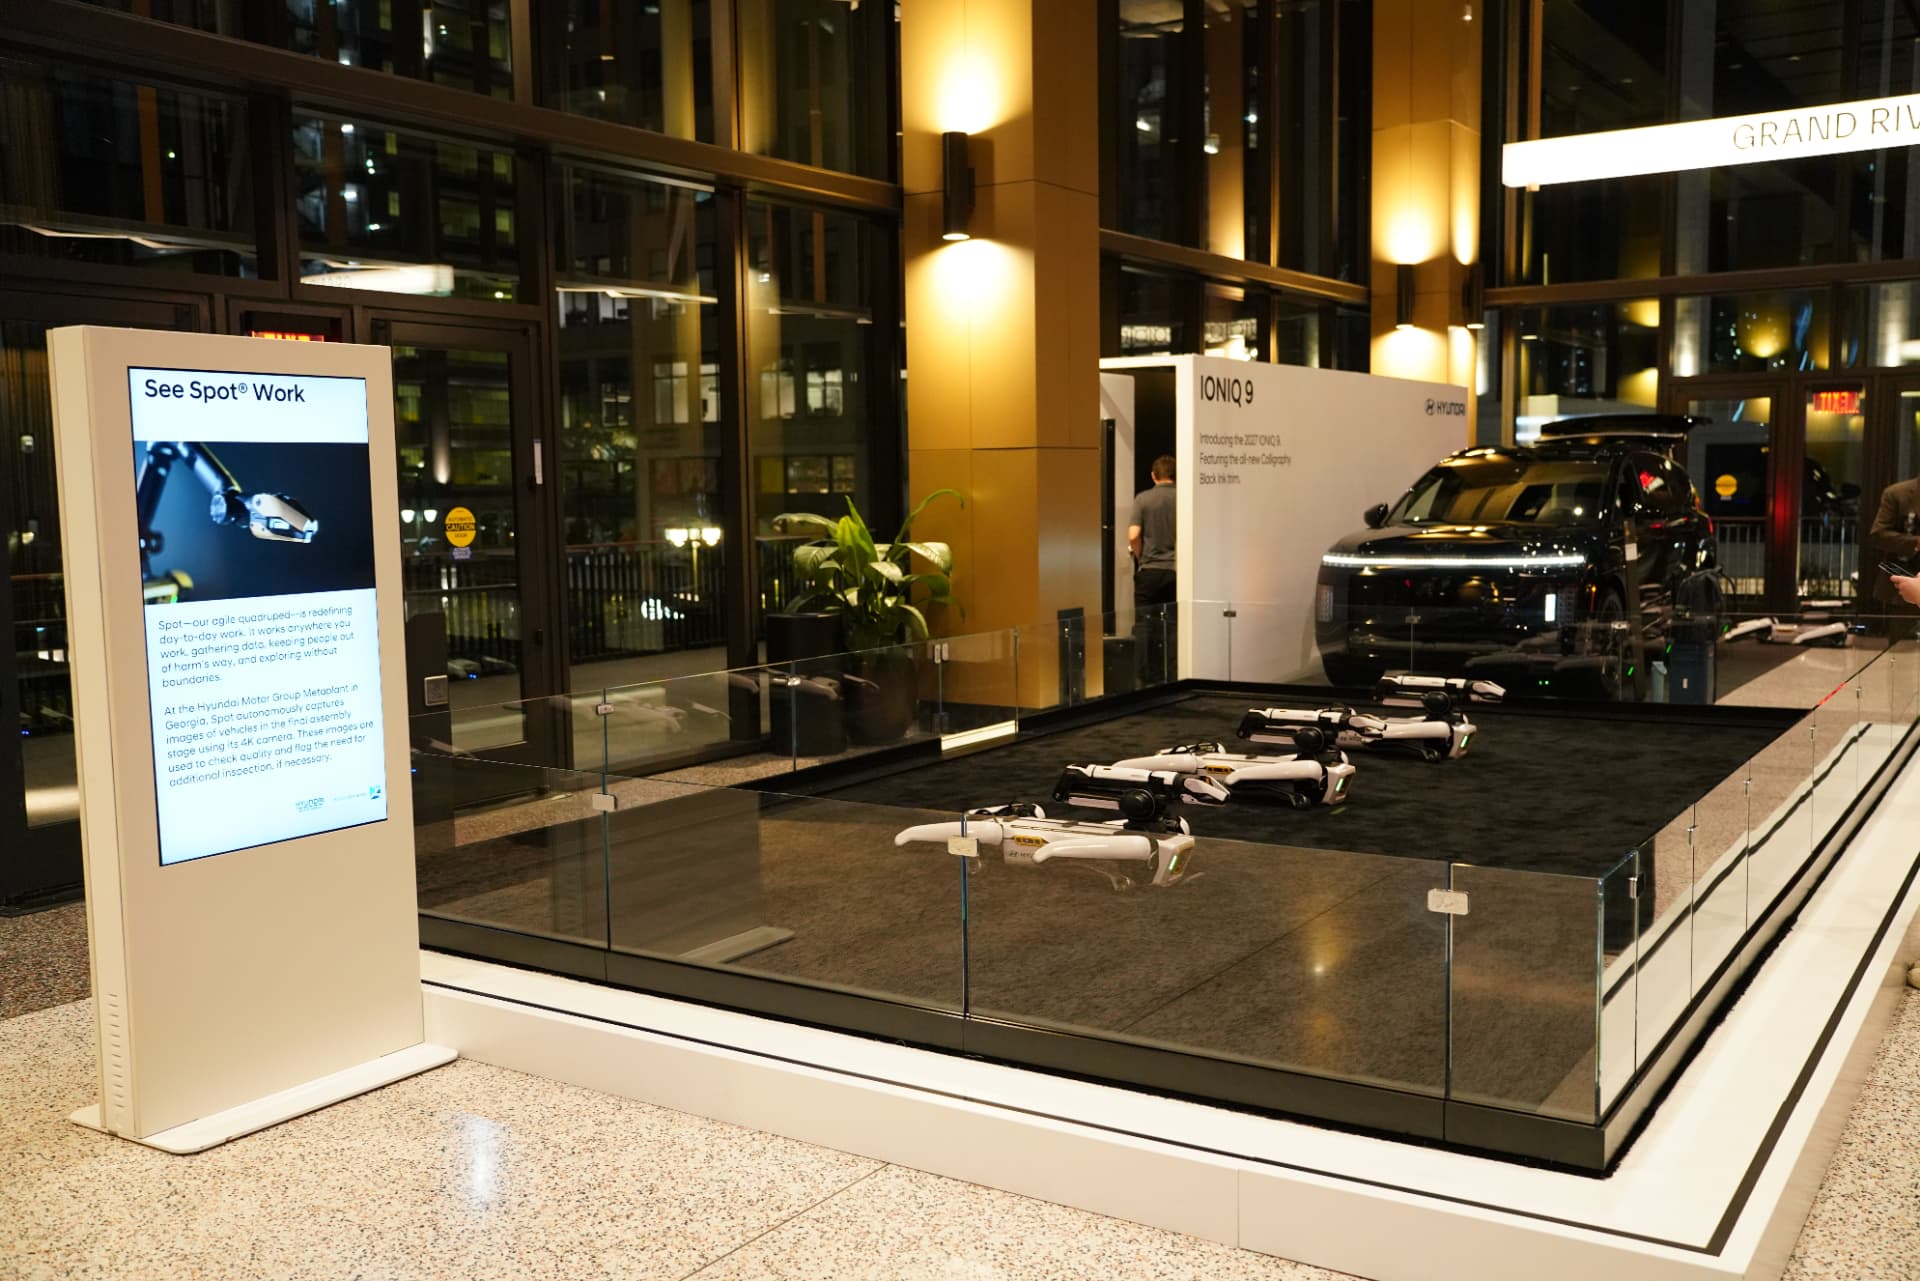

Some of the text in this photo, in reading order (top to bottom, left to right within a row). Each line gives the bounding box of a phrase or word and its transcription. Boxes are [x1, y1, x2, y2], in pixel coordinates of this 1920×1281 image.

[1733, 112, 1857, 150] GRAND
[145, 379, 306, 403] See Spot® Work
[1200, 375, 1253, 408] IONIQ 9
[1200, 432, 1233, 448] Introducing
[1233, 434, 1243, 446] the
[1259, 434, 1276, 448] IONIQ
[1200, 452, 1291, 468] Featuring the all-new Calligraphy
[1200, 472, 1216, 484] Black
[446, 523, 475, 531] CAUTION
[212, 616, 236, 627] agile
[308, 606, 352, 616] redefining
[160, 632, 217, 645] day-to-day
[258, 625, 285, 635] works
[288, 621, 332, 632] anywhere
[335, 620, 351, 629] you
[192, 645, 239, 657] gathering
[269, 638, 305, 647] keeping
[308, 634, 338, 646] people
[340, 632, 354, 641] out
[162, 663, 171, 673] of
[212, 659, 236, 668] way,
[238, 654, 257, 665] and
[259, 651, 302, 663] exploring
[304, 648, 337, 657] without
[162, 673, 222, 688] boundaries.
[164, 684, 358, 715] At the Hyundai Motor Group Metaplant in
[166, 699, 344, 730] Georgia, Spot autonomously captures
[167, 710, 352, 744] images of vehicles in the final assembly
[168, 720, 374, 759] stage using its 4K camera. These images are
[168, 734, 366, 772] used to check quality and flag the need for
[170, 769, 220, 787] additional
[276, 760, 282, 769] if
[285, 754, 332, 767] necessary.
